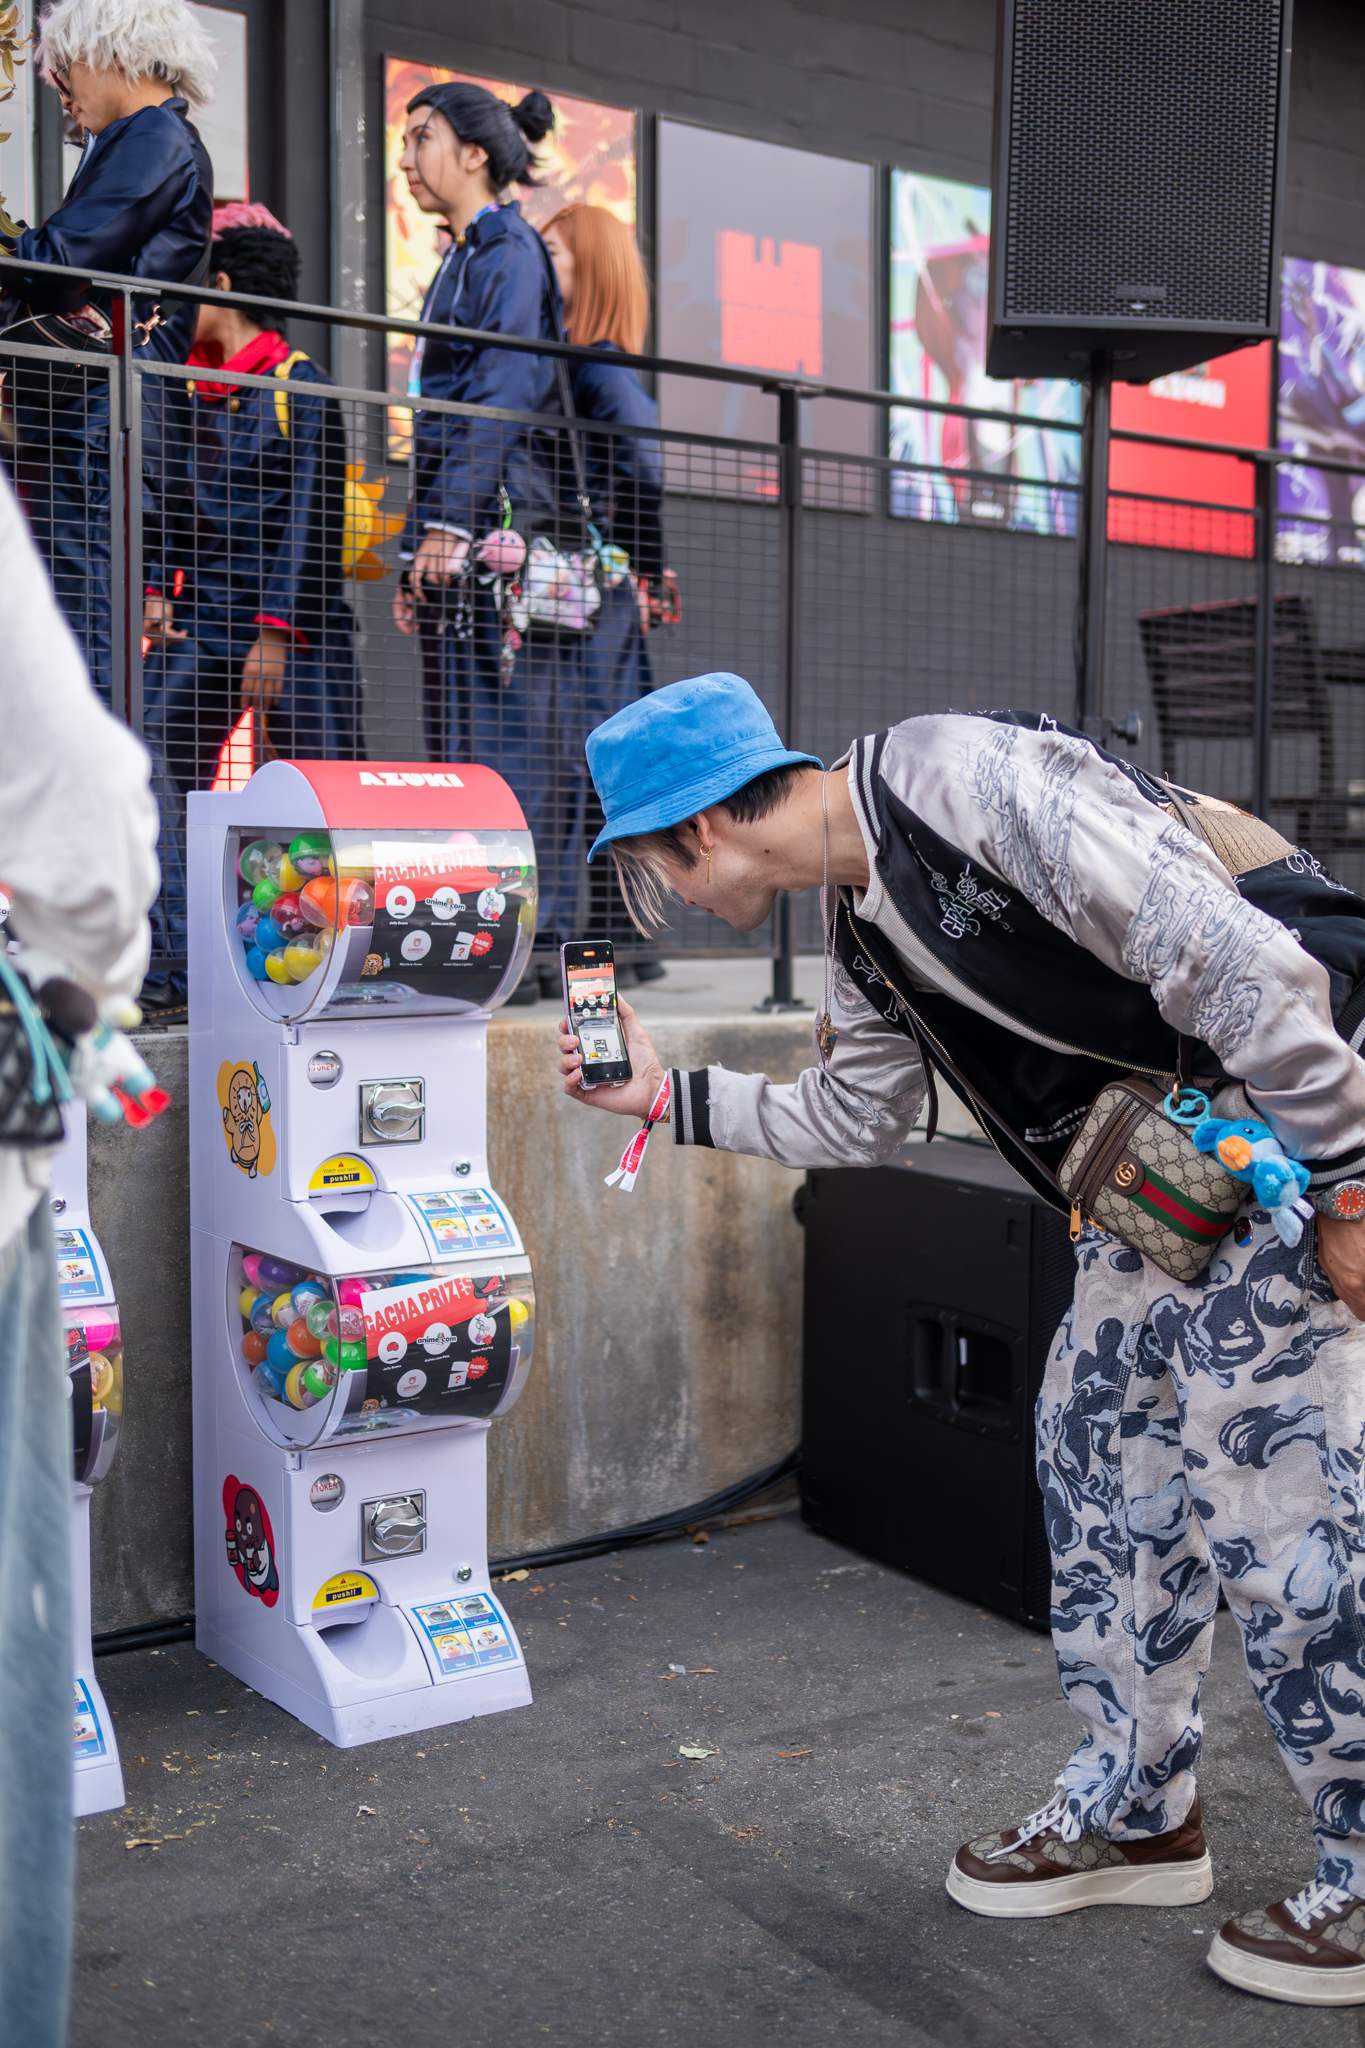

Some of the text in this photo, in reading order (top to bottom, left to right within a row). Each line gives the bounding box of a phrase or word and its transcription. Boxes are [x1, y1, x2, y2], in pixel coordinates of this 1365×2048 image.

[359, 772, 465, 787] AZUKI
[431, 846, 488, 876] PRIZES
[312, 1063, 335, 1071] TOKEN
[418, 1274, 472, 1315] PRIZES
[315, 1482, 338, 1492] TOKEN
